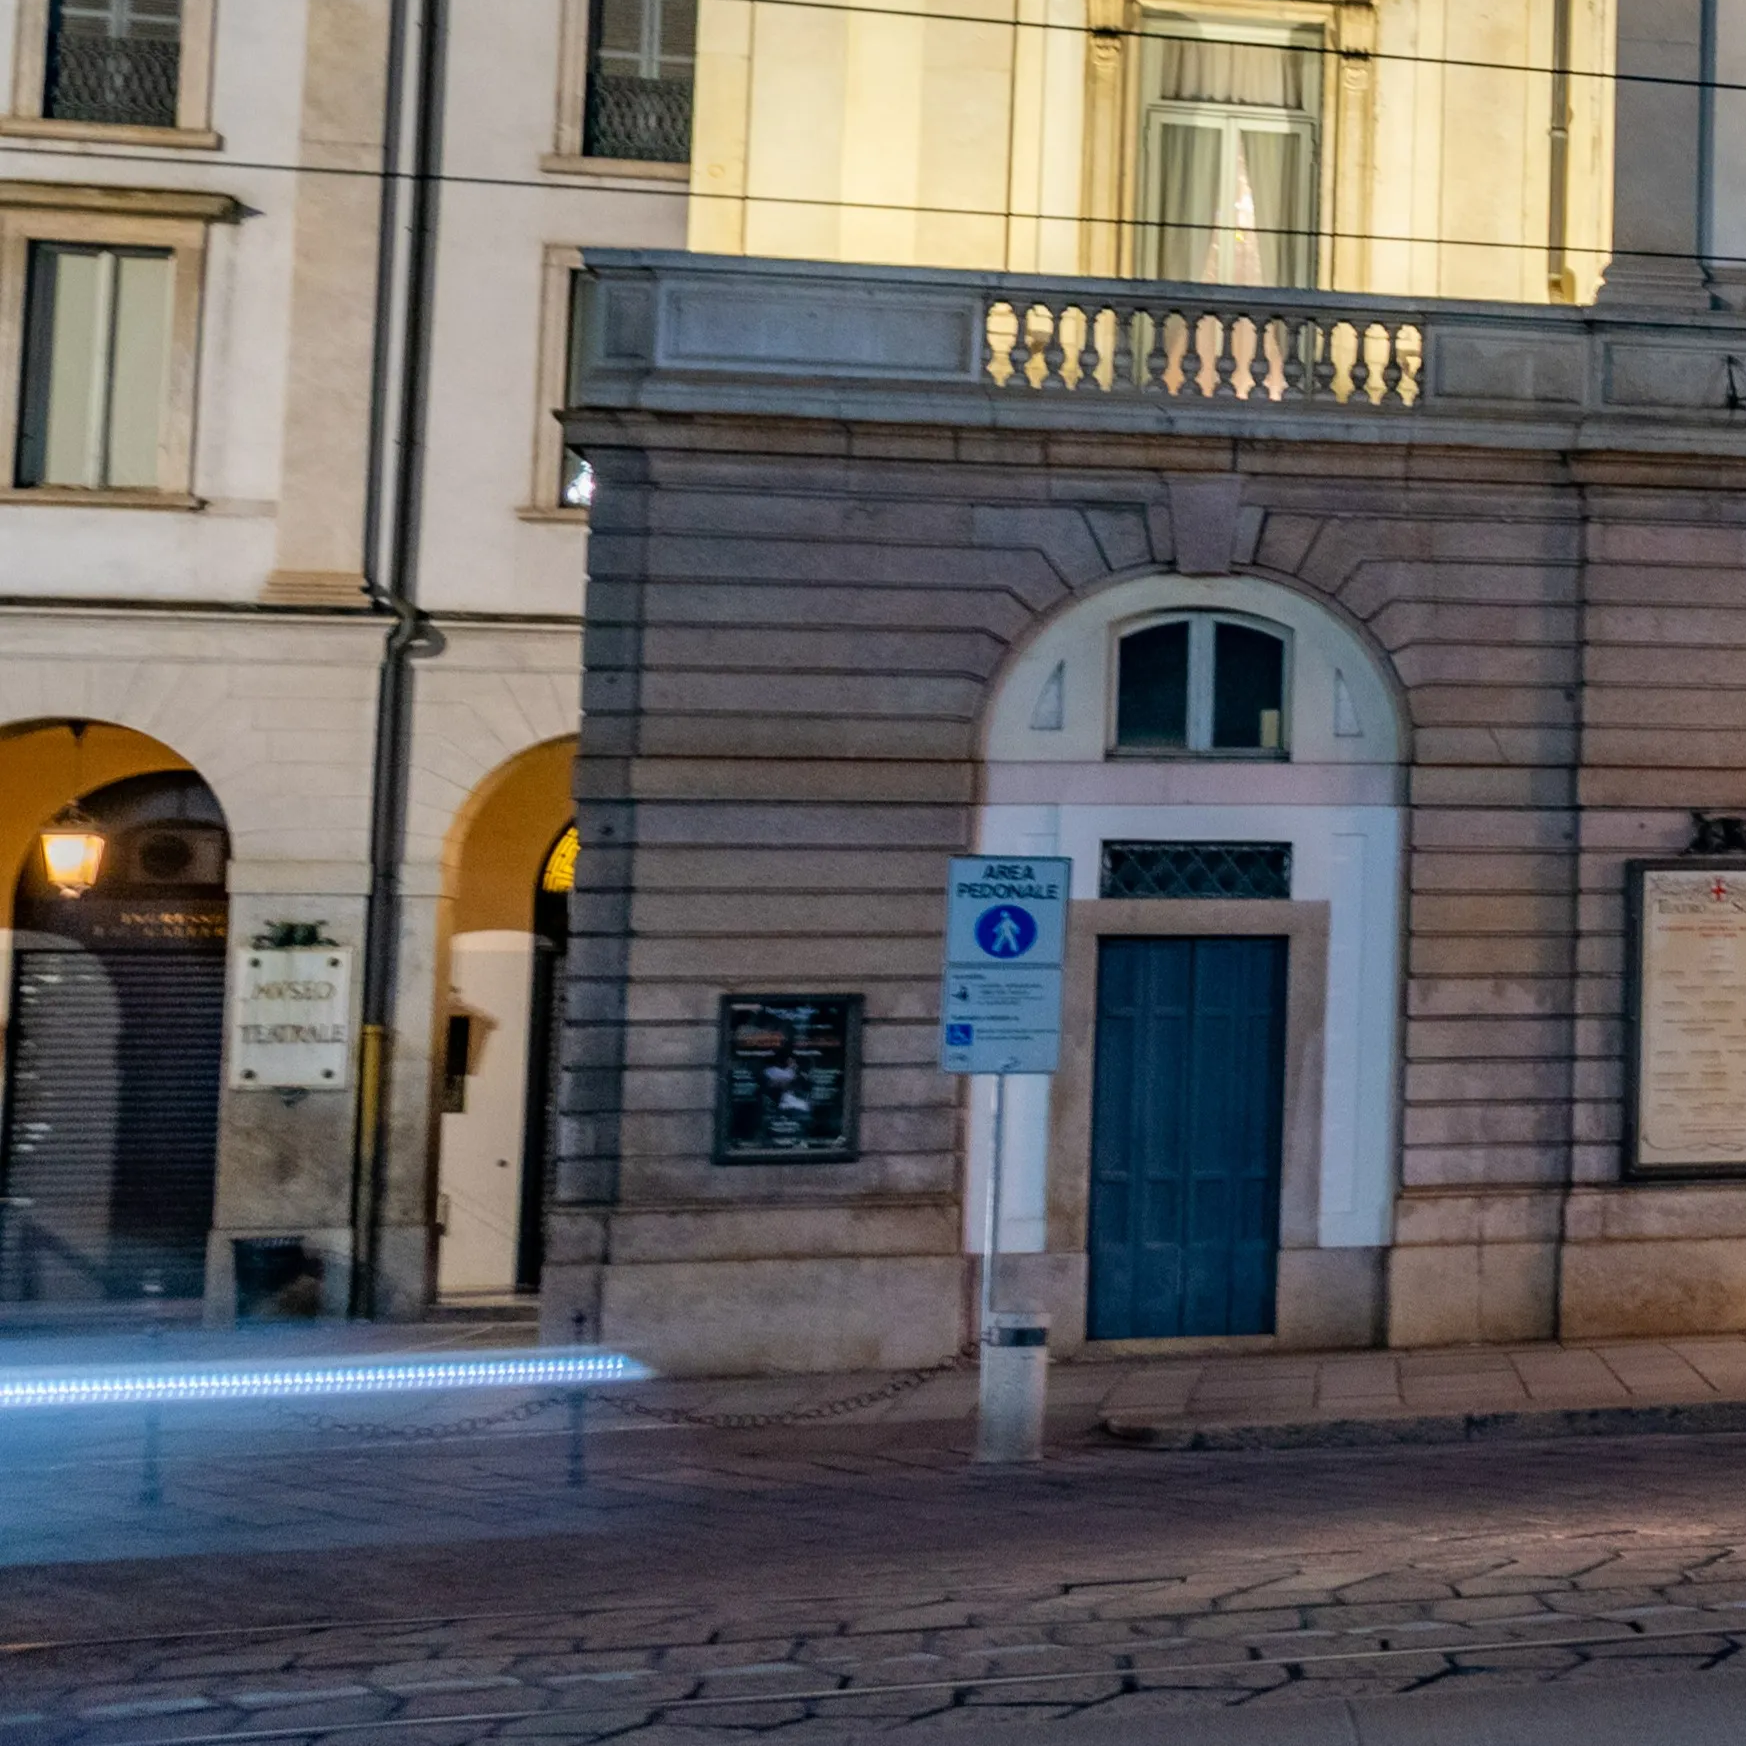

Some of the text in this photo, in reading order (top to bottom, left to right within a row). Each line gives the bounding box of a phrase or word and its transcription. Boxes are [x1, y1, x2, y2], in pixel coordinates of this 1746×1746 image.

[982, 864, 1035, 881] AREA
[956, 882, 1058, 900] PEDONALE
[240, 1023, 347, 1044] TEATRALE
